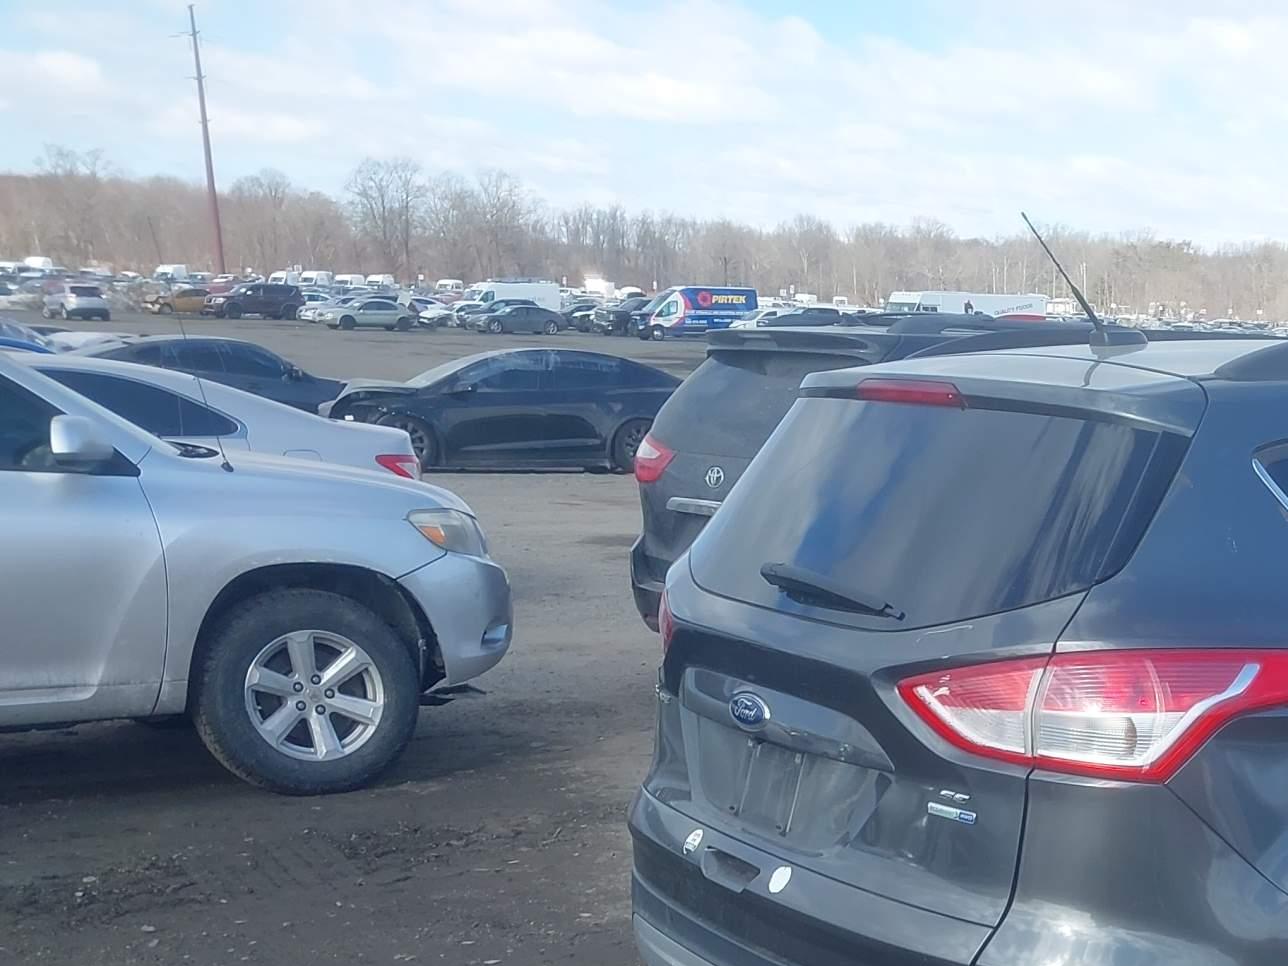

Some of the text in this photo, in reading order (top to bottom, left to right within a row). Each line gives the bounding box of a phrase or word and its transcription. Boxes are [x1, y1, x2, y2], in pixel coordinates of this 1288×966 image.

[712, 295, 747, 304] PIRTEK
[734, 698, 758, 721] Ford
[938, 790, 970, 804] SE
